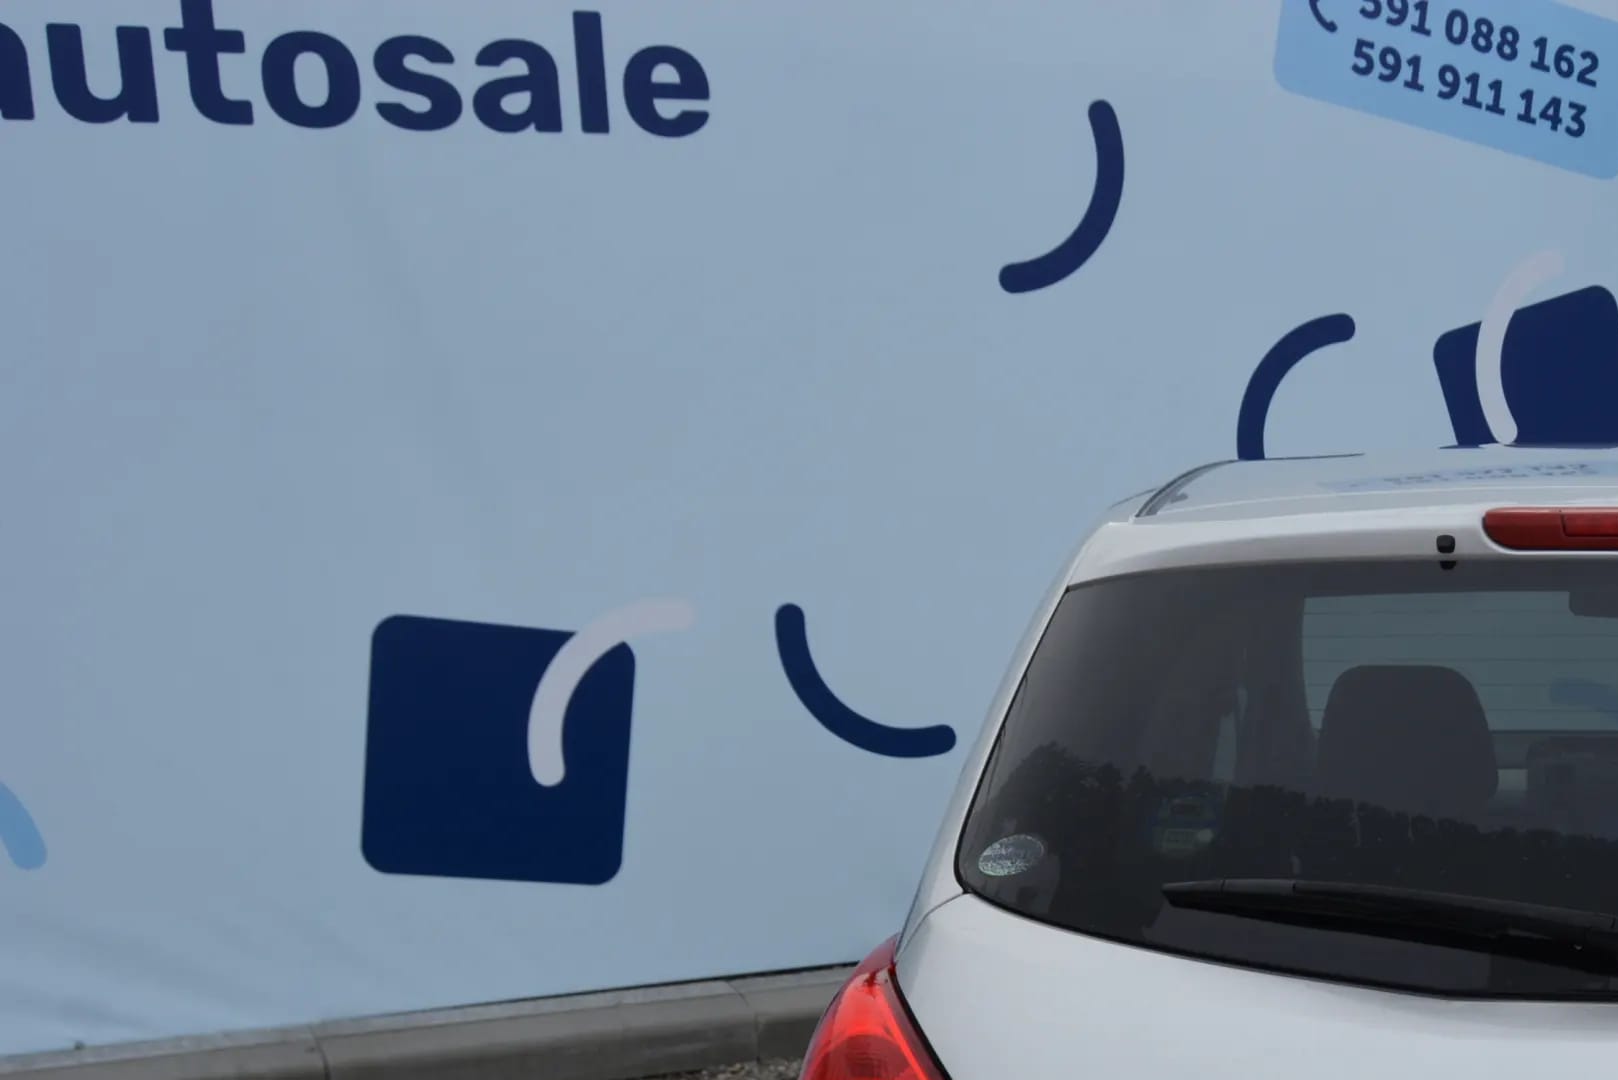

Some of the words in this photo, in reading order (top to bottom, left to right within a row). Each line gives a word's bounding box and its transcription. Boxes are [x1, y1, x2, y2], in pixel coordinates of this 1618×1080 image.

[1351, 38, 1425, 92] 591
[1436, 63, 1506, 116] 911
[1516, 89, 1588, 138] 143
[1444, 8, 1521, 62] 088
[1530, 36, 1600, 88] 162
